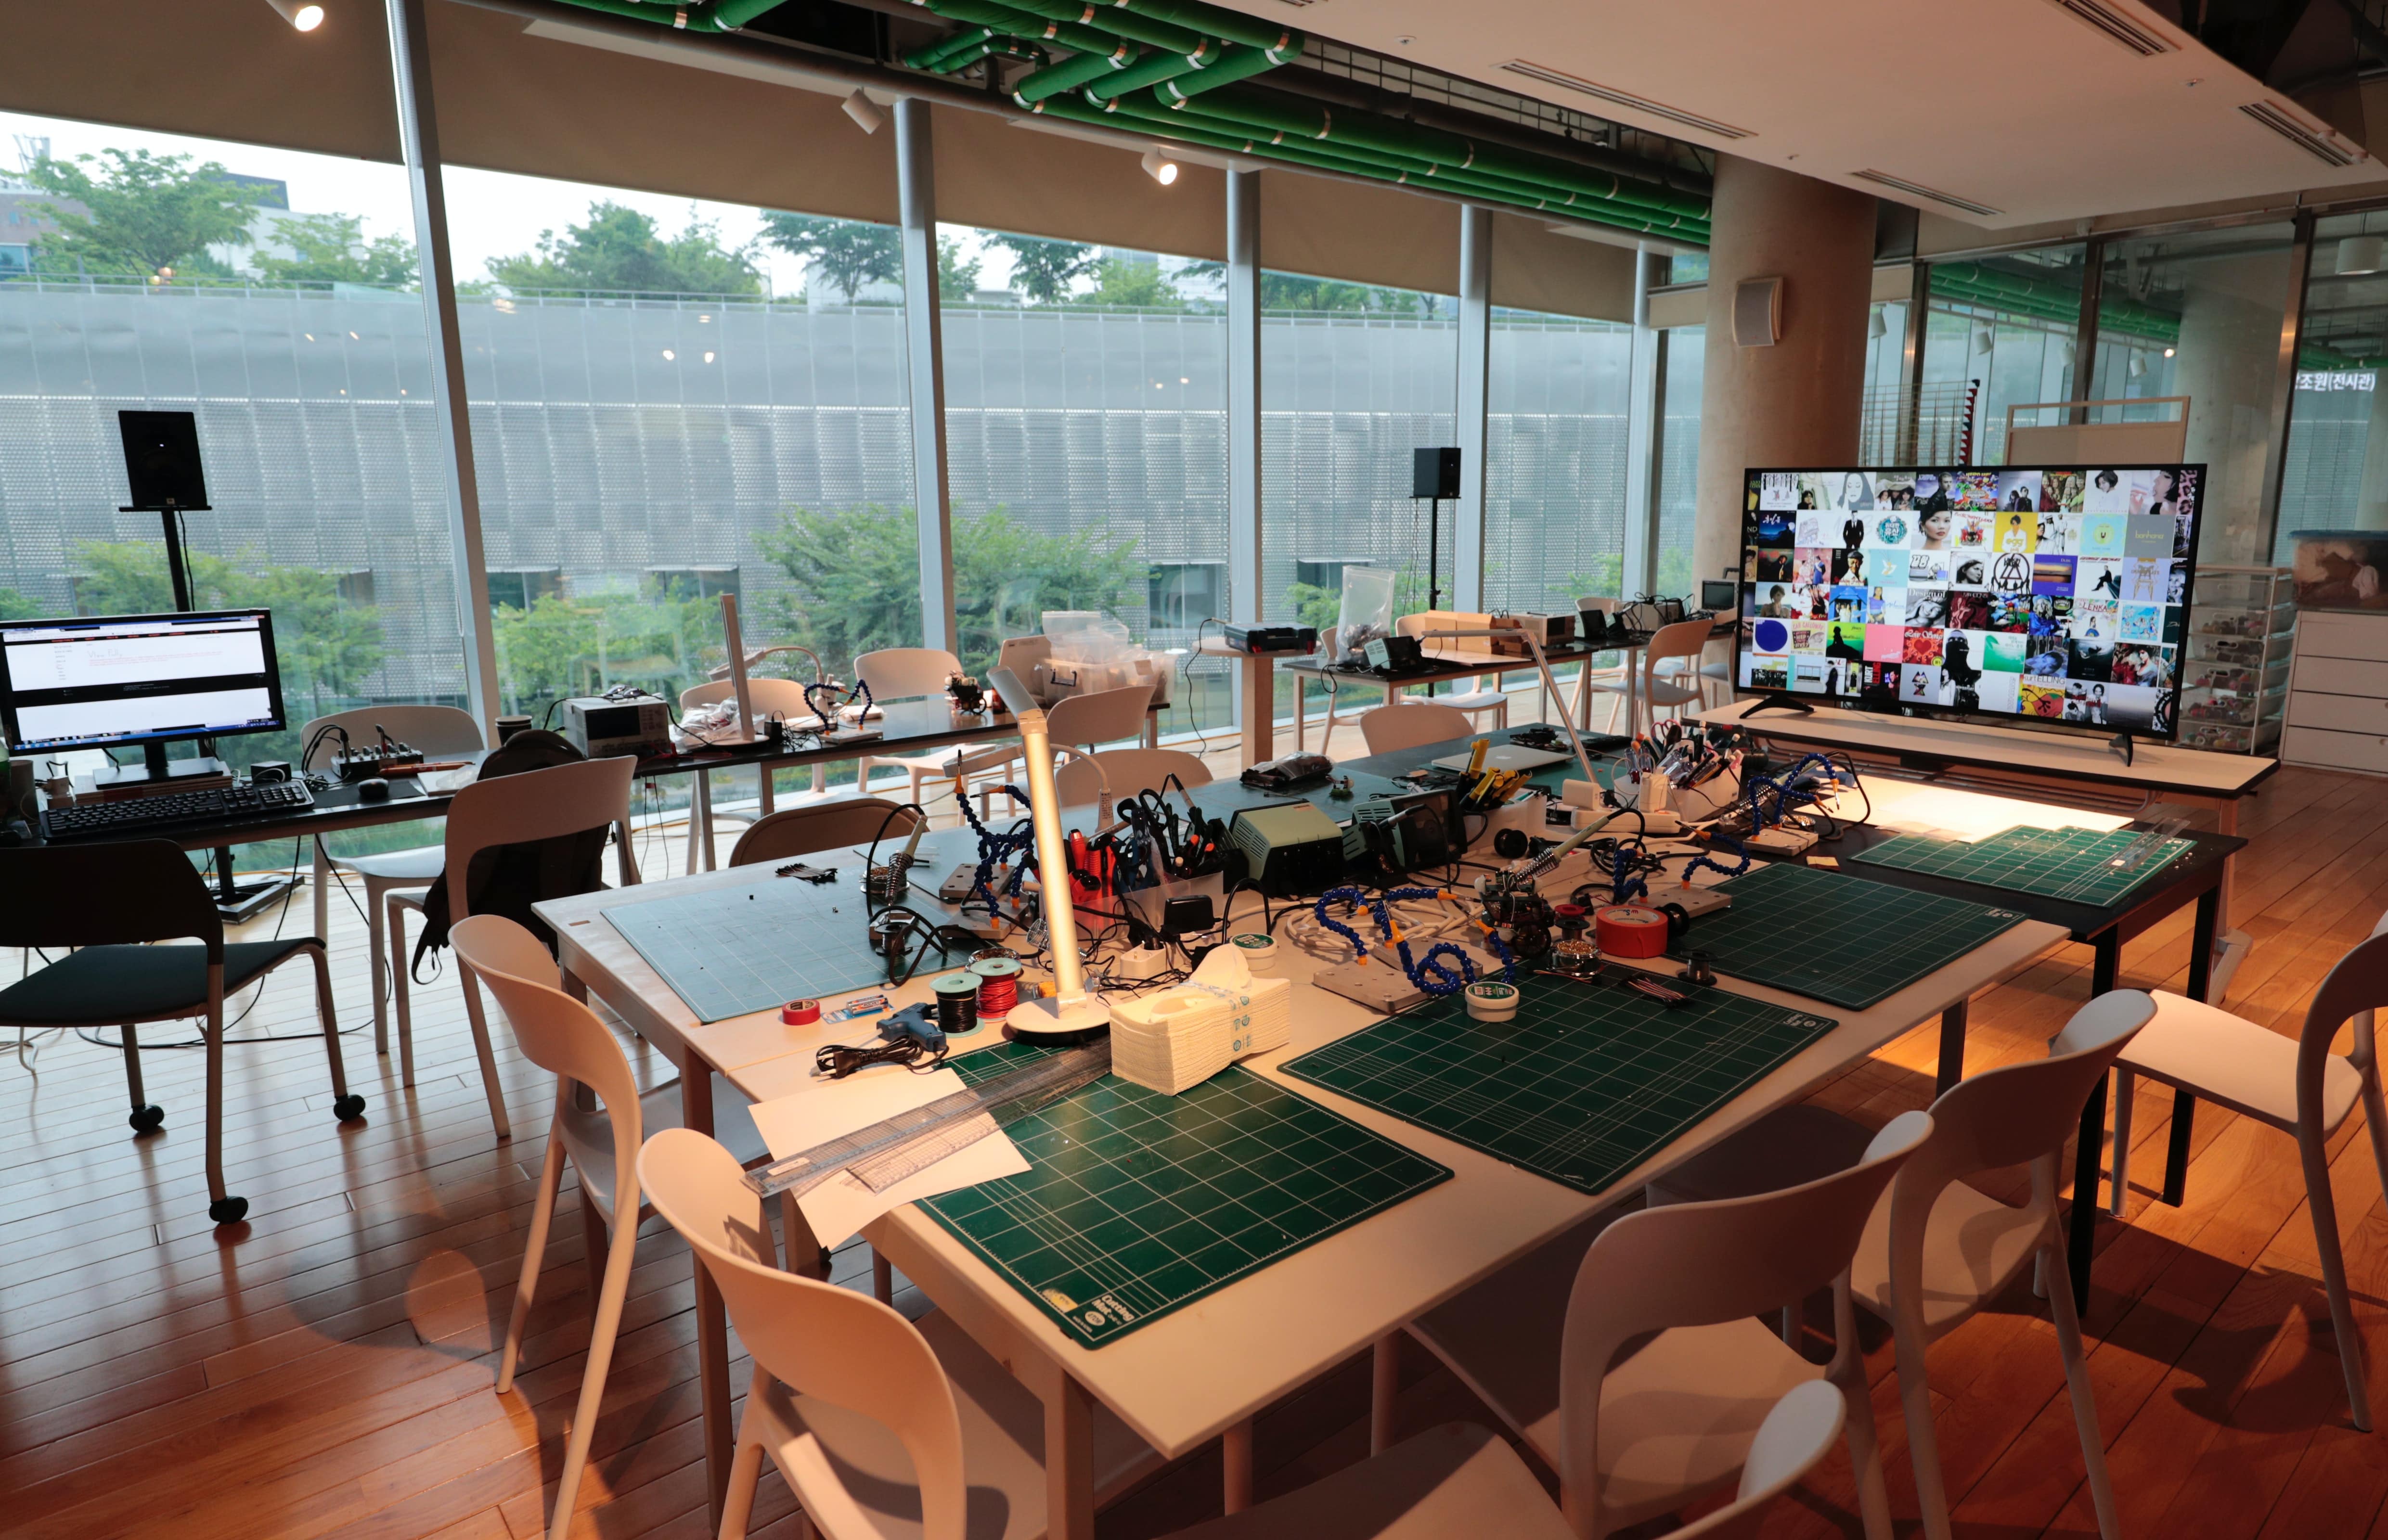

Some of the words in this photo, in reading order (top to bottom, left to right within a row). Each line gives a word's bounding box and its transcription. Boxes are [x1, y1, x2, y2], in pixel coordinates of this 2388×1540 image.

[1885, 528, 1899, 537] 유산
[2082, 601, 2107, 612] LENKA
[1864, 666, 1873, 683] KURT
[2037, 675, 2065, 685] ELLING
[1091, 1299, 1112, 1316] Mat
[1101, 1295, 1135, 1322] Cutting
